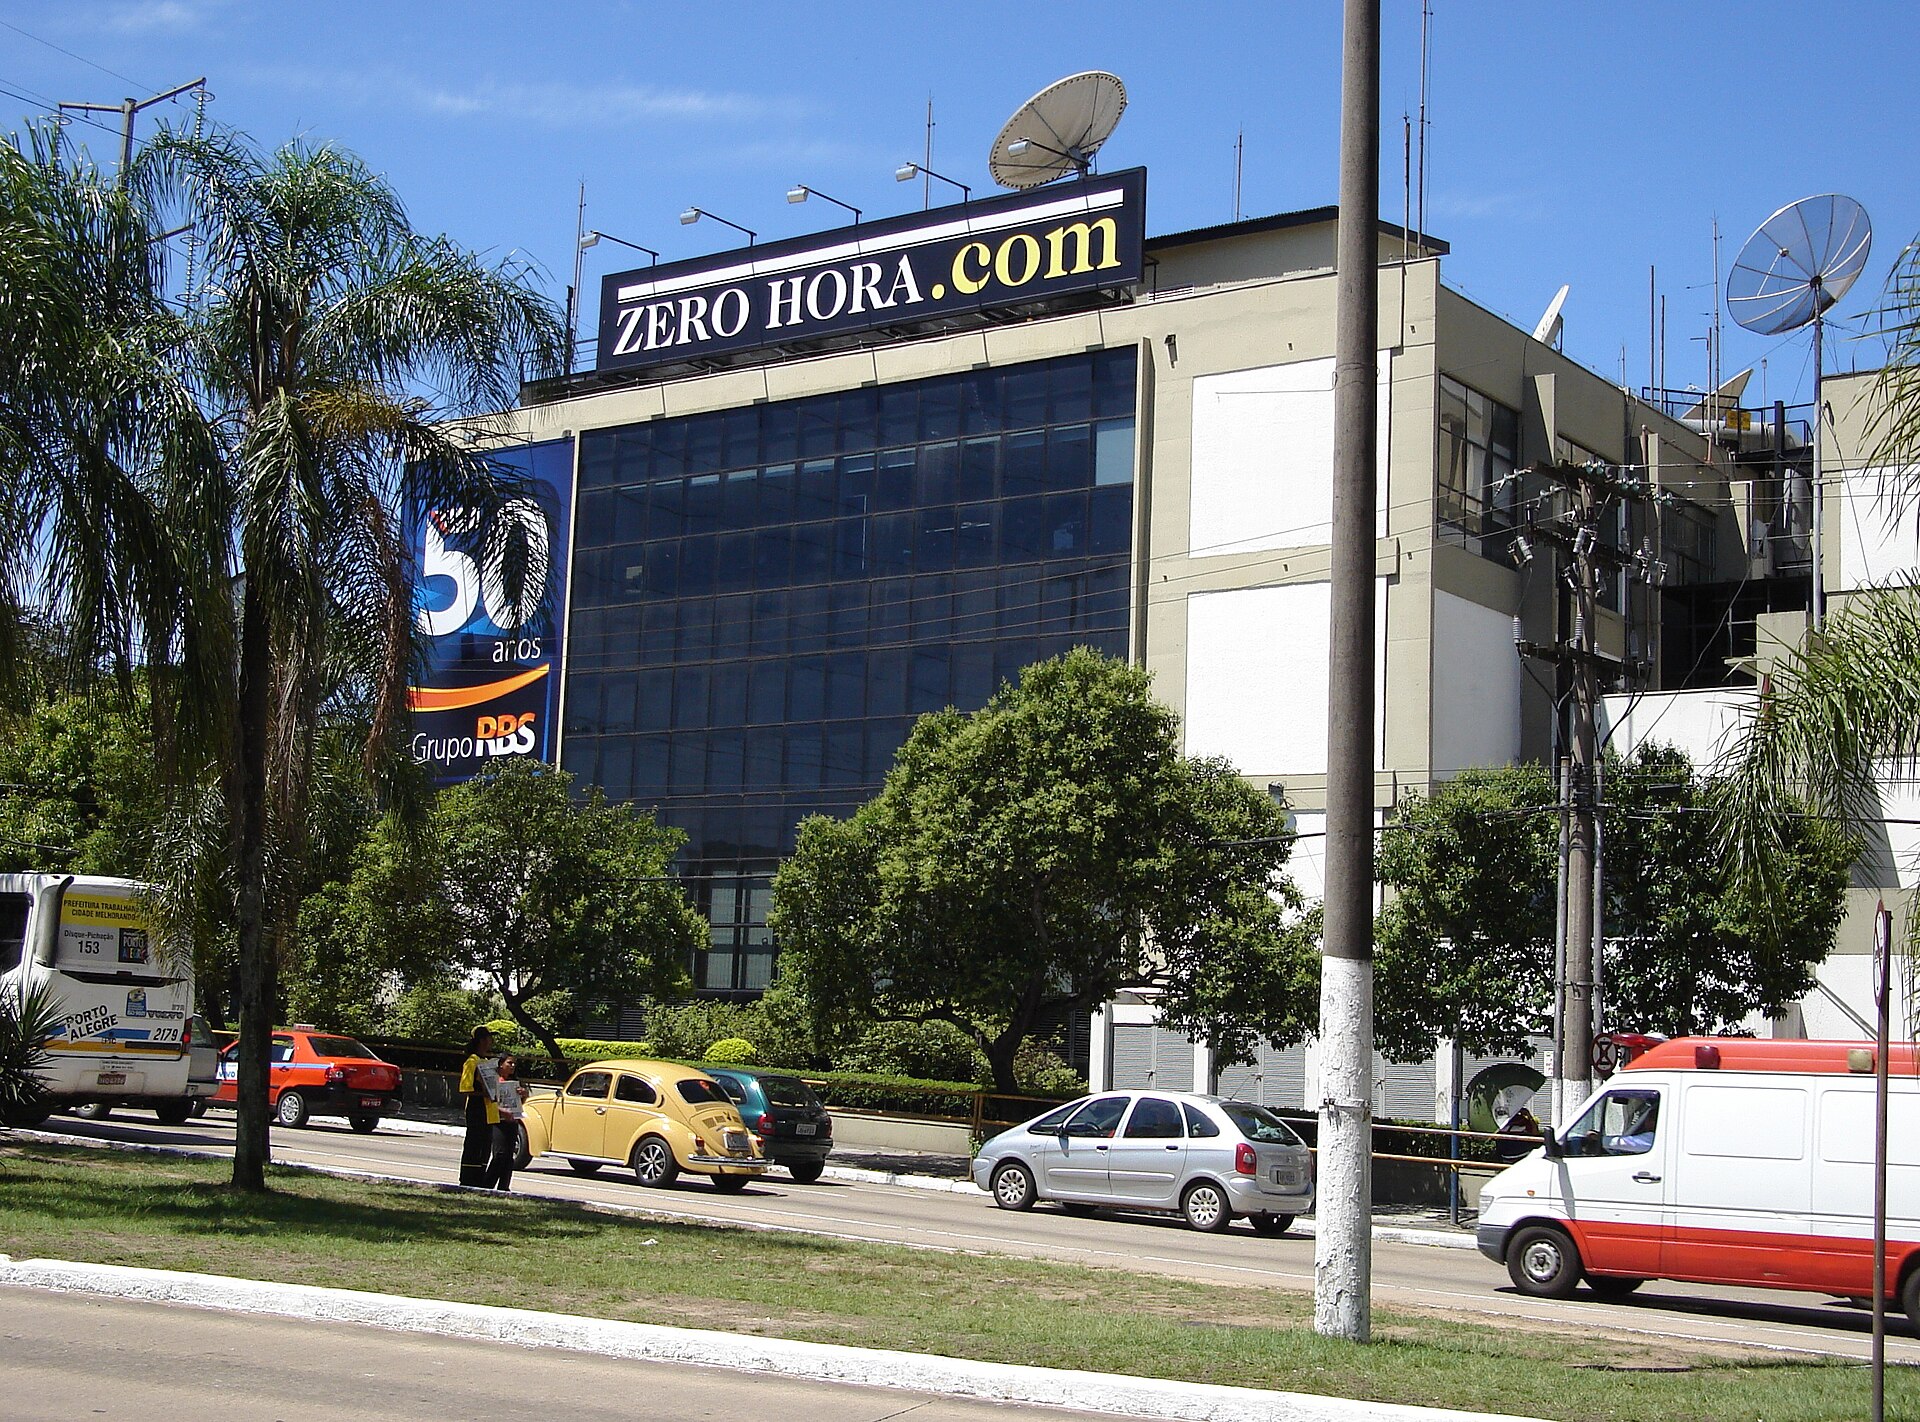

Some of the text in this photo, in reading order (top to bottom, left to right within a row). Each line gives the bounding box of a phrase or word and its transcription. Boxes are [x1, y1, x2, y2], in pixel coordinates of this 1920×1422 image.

[612, 215, 1121, 356] ZERO HORA .com
[417, 498, 549, 636] 50
[493, 637, 541, 663] anos
[413, 712, 536, 766] Grupo RBS
[64, 900, 139, 912] PREFEITURA TRABALHAN
[72, 909, 94, 917] CIDADE
[78, 941, 100, 954] 153
[66, 1004, 108, 1029] PORTO
[70, 1014, 119, 1041] ALEGRE
[153, 1027, 179, 1041] 2179
